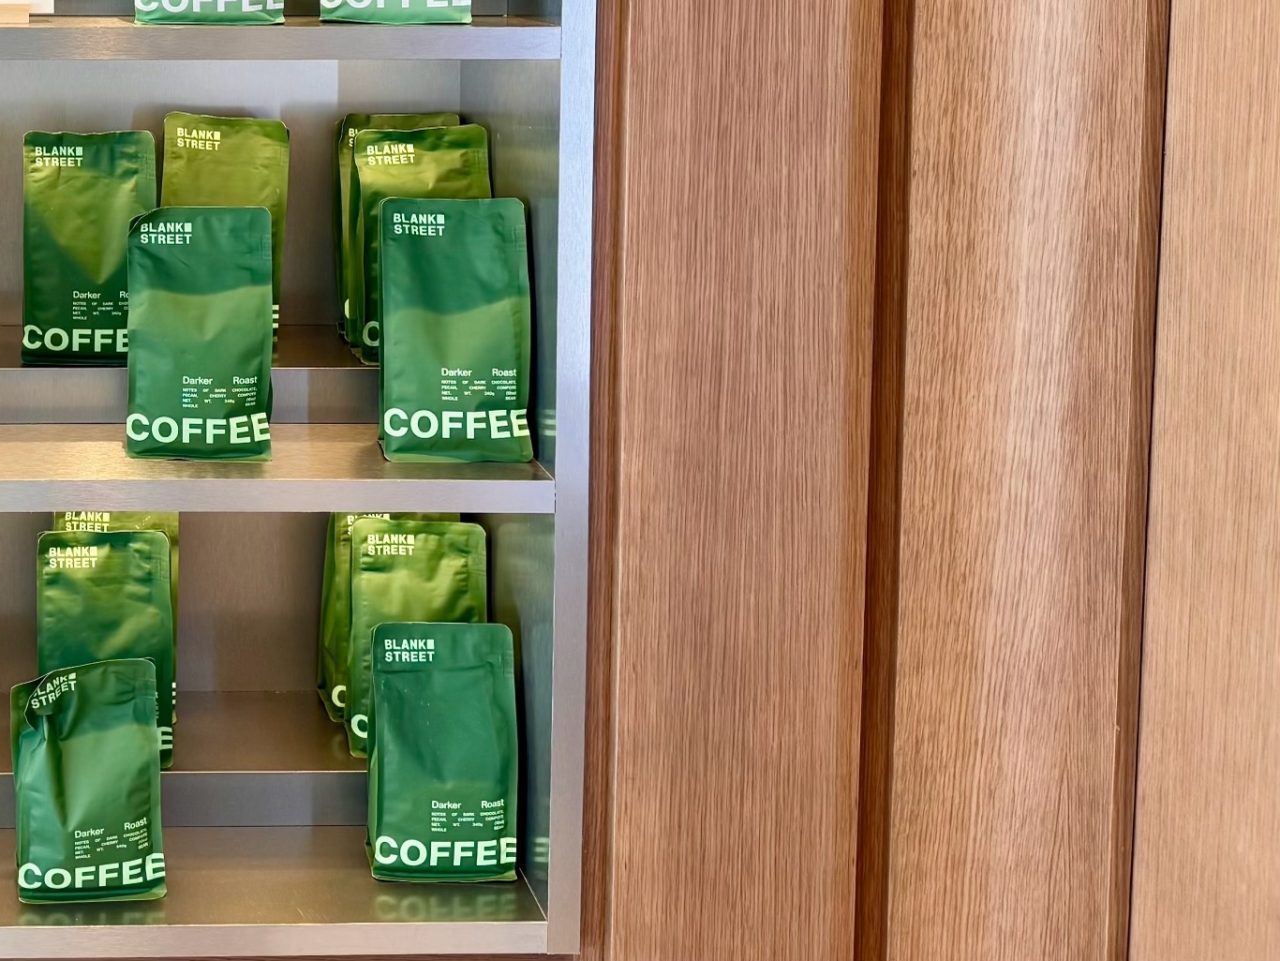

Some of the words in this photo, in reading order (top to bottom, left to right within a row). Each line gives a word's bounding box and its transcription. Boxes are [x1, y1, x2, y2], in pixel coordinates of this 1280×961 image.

[177, 127, 214, 140] BLANK
[177, 138, 220, 151] STREET
[367, 144, 408, 155] BLANK
[35, 146, 76, 156] BLANK
[35, 157, 83, 167] STREET
[368, 154, 415, 166] STREET
[393, 213, 437, 224] BLANK
[140, 222, 184, 233] BLANK
[394, 225, 445, 237] STREET
[140, 234, 192, 244] STREET
[73, 291, 101, 299] Darker
[22, 324, 129, 352] COFFE
[441, 368, 472, 377] Darker
[492, 368, 517, 377] Roast
[182, 376, 213, 385] Darker
[233, 376, 258, 385] Roast
[126, 412, 271, 444] COFFEE
[384, 407, 530, 439] COFFEE
[65, 512, 103, 522] BLANK
[65, 522, 109, 532] STREET
[368, 534, 408, 545] BLANK
[49, 546, 91, 557] BLANK
[368, 544, 415, 556] STREET
[49, 557, 98, 569] STREET
[385, 639, 427, 650] BLANK
[385, 651, 435, 662] STREET
[34, 675, 68, 697] LANK
[31, 681, 77, 709] STREET
[431, 800, 462, 809] Darker
[481, 799, 504, 808] Roast
[75, 828, 104, 838] Darker
[124, 816, 148, 830] Roast
[374, 835, 517, 866] COFFEE
[18, 852, 166, 889] COFFEE
